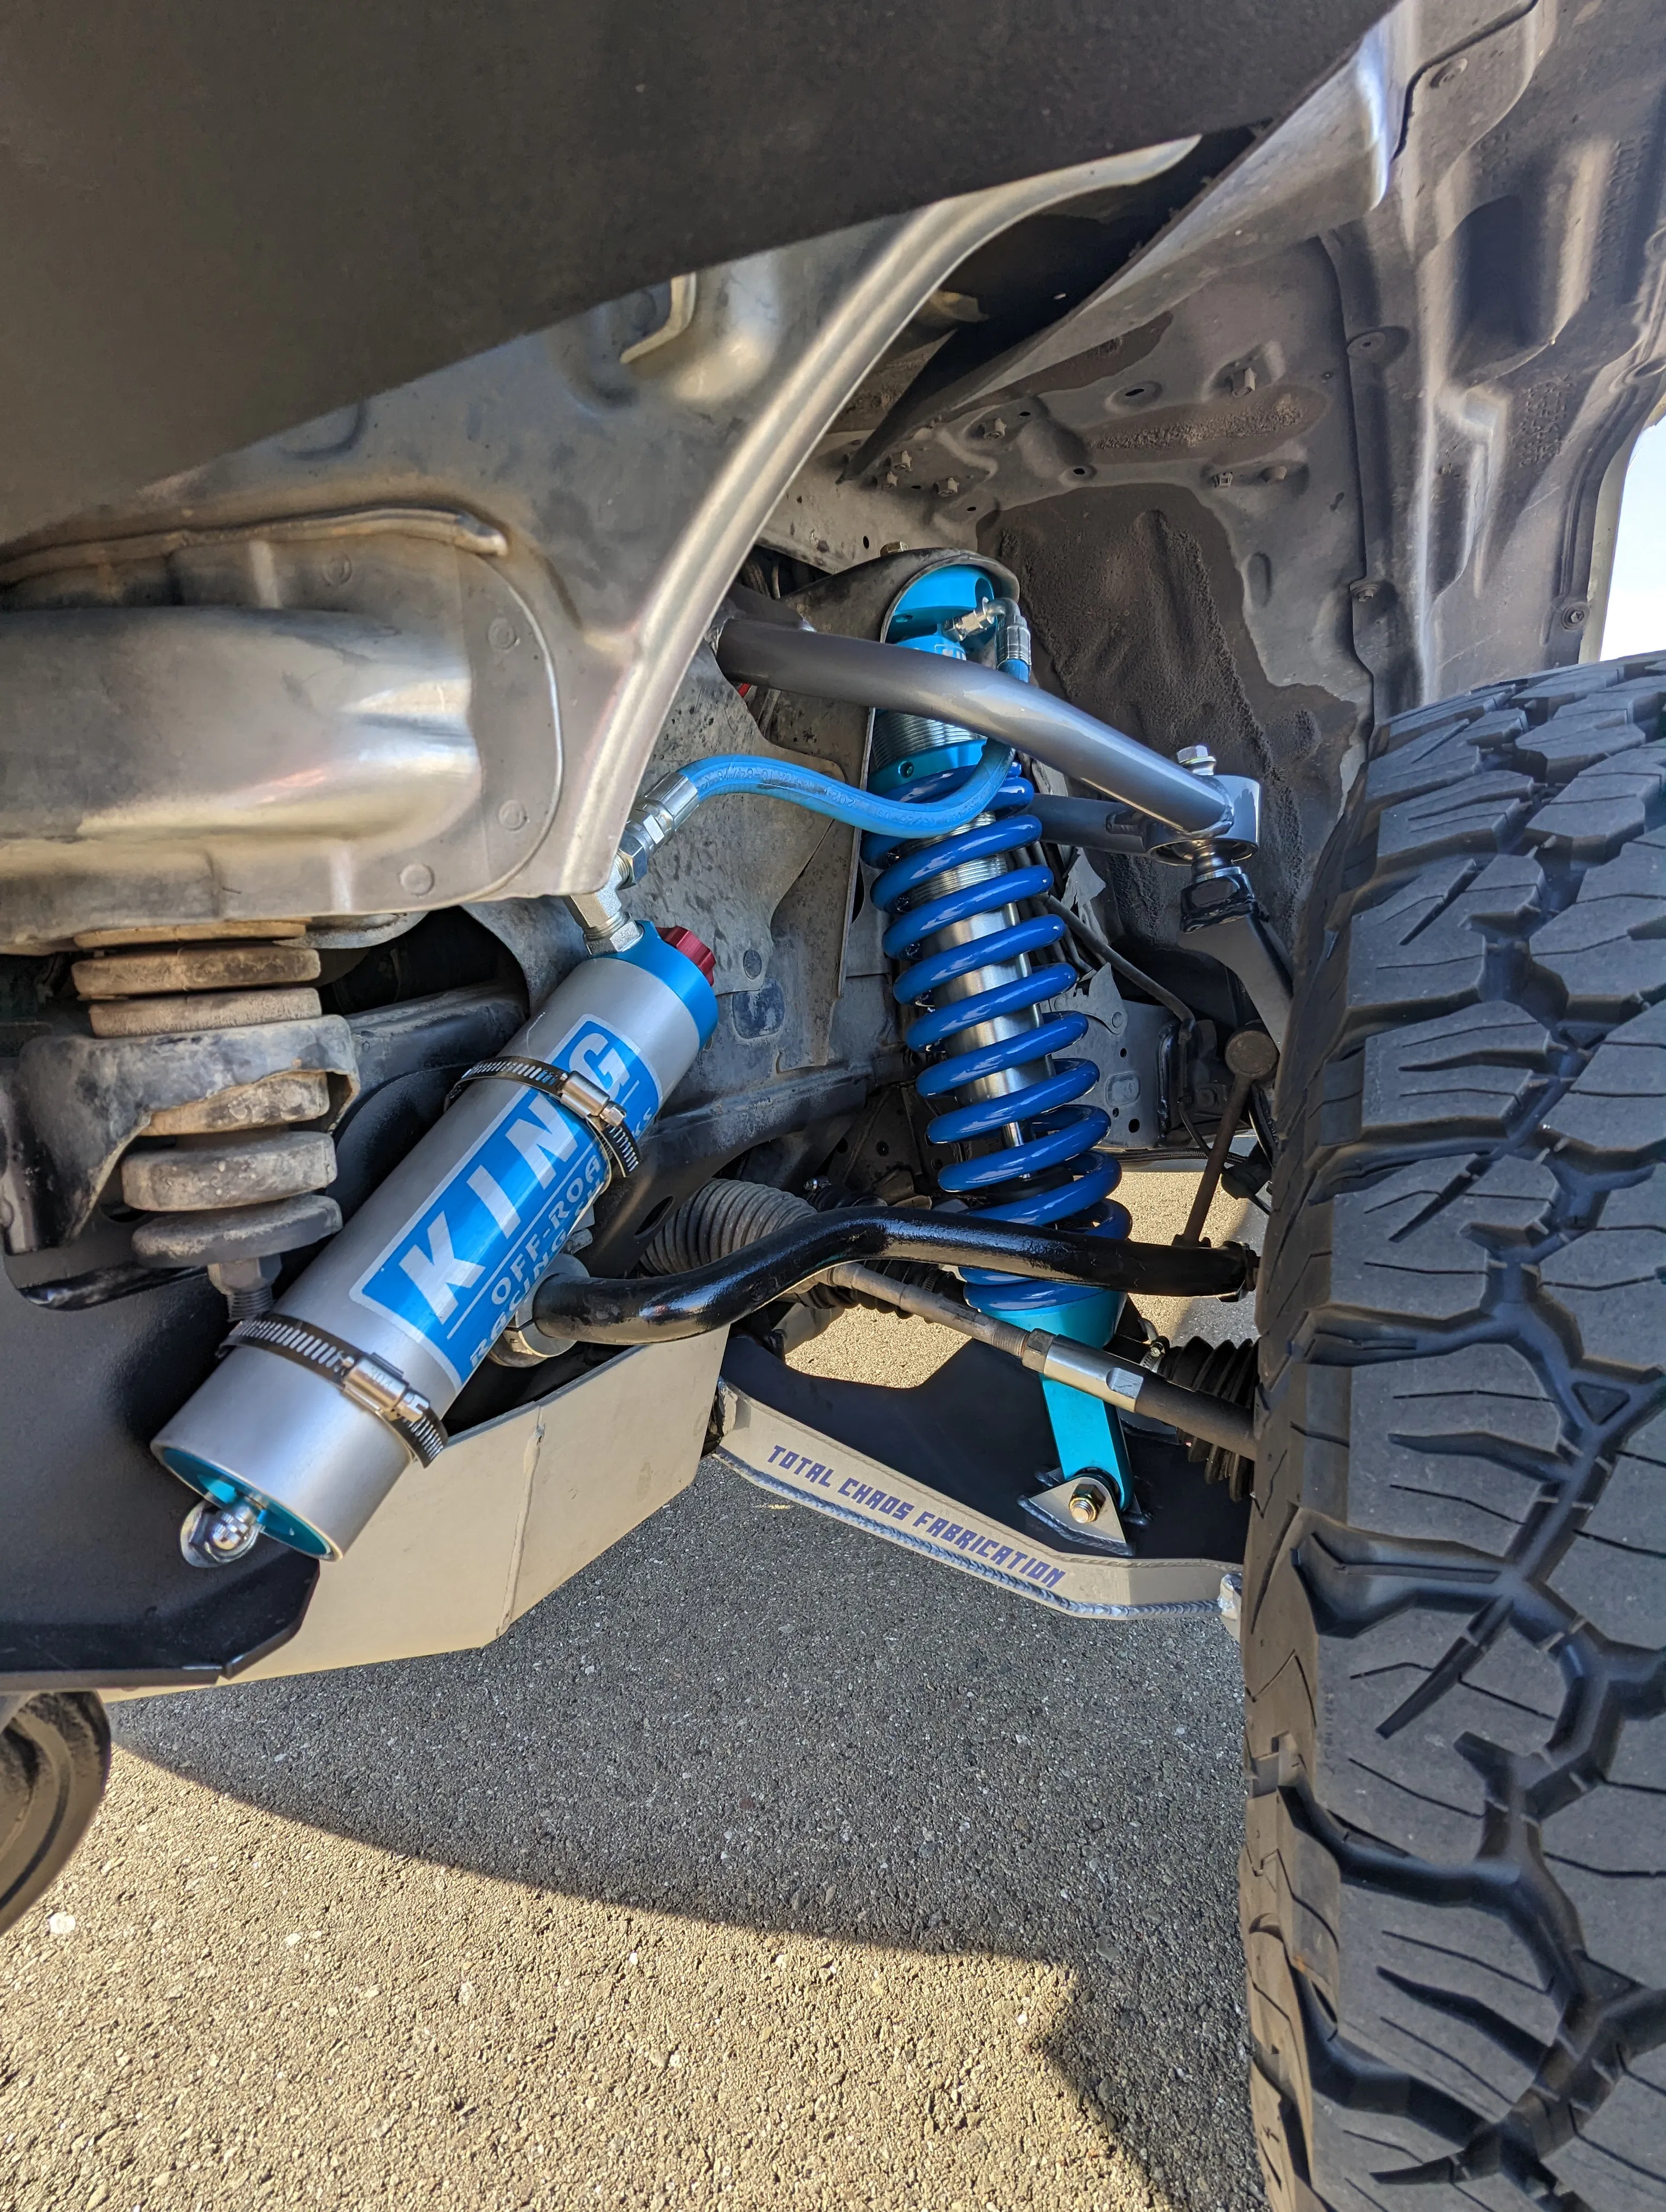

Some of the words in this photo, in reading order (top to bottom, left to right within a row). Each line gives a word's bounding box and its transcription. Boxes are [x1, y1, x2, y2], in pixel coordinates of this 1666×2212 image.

[399, 1032, 631, 1325] KING
[491, 1154, 602, 1305] OFF-ROA
[767, 1445, 835, 1487] TOTAL
[837, 1477, 914, 1521] CHAOS
[913, 1510, 1066, 1589] FABRICATION
